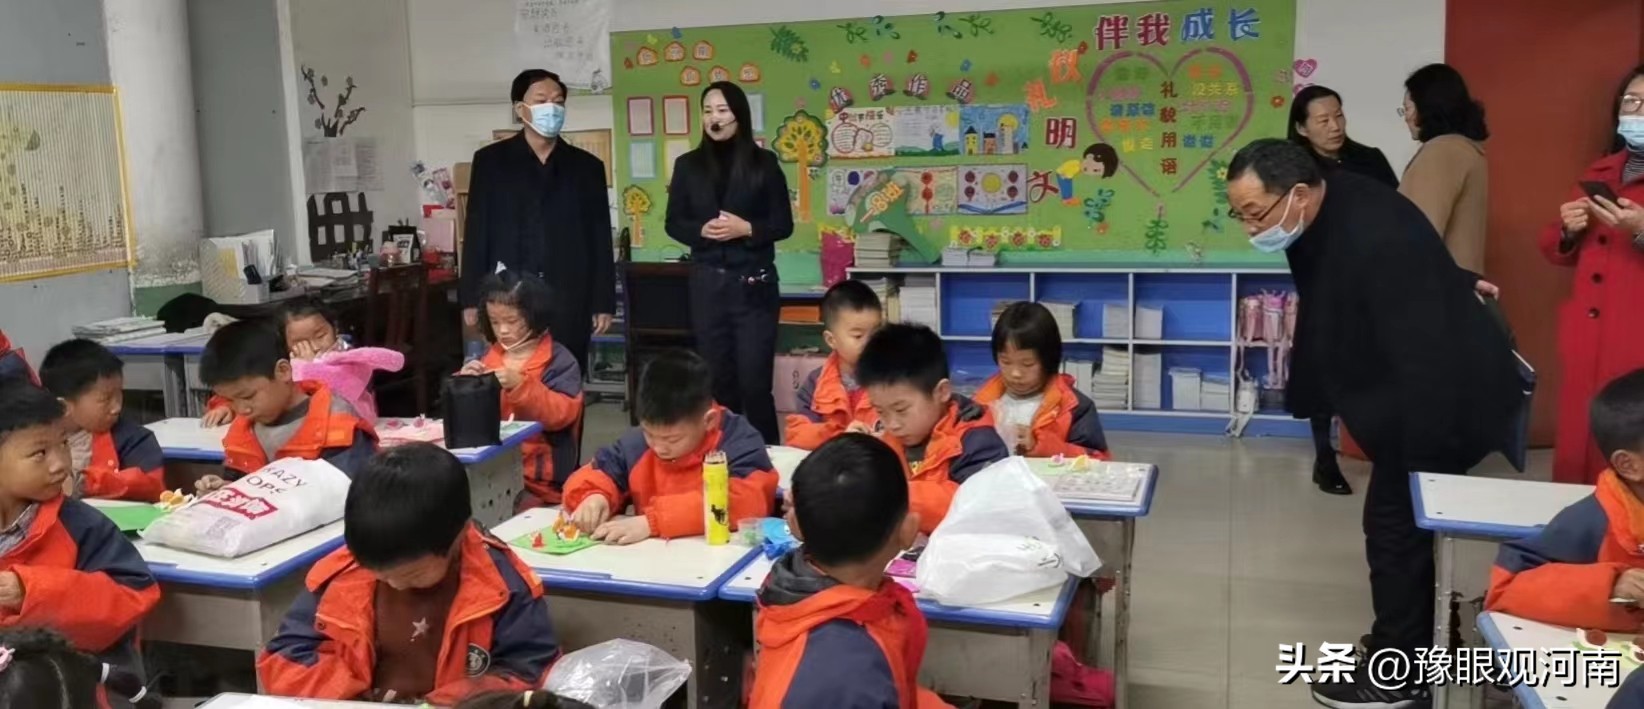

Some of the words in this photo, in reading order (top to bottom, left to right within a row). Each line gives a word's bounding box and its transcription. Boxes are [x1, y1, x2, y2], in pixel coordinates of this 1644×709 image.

[1095, 8, 1261, 50] 伴我成长
[830, 73, 972, 108] 优秀作品
[1192, 82, 1238, 96] 没关系
[1160, 81, 1178, 175] 礼貌用语
